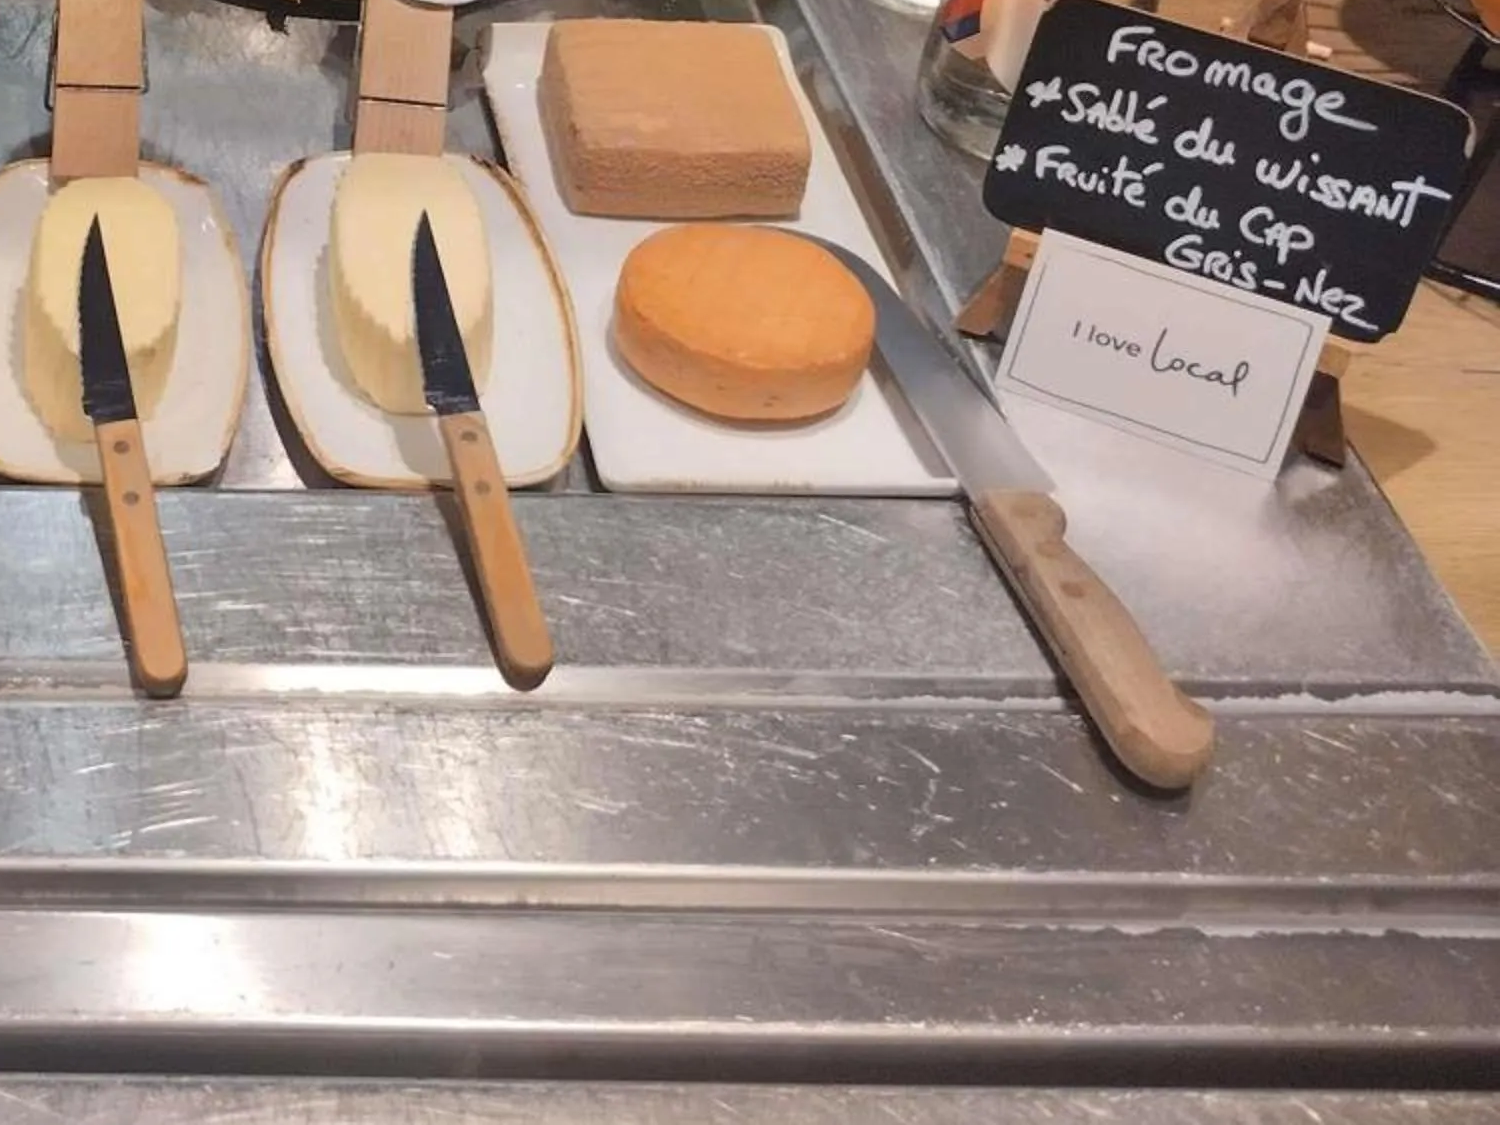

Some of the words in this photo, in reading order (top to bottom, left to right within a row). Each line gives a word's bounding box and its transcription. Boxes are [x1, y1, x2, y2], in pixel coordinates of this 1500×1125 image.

[1173, 117, 1236, 166] du
[1164, 185, 1221, 229] du
[1088, 325, 1141, 358] love
